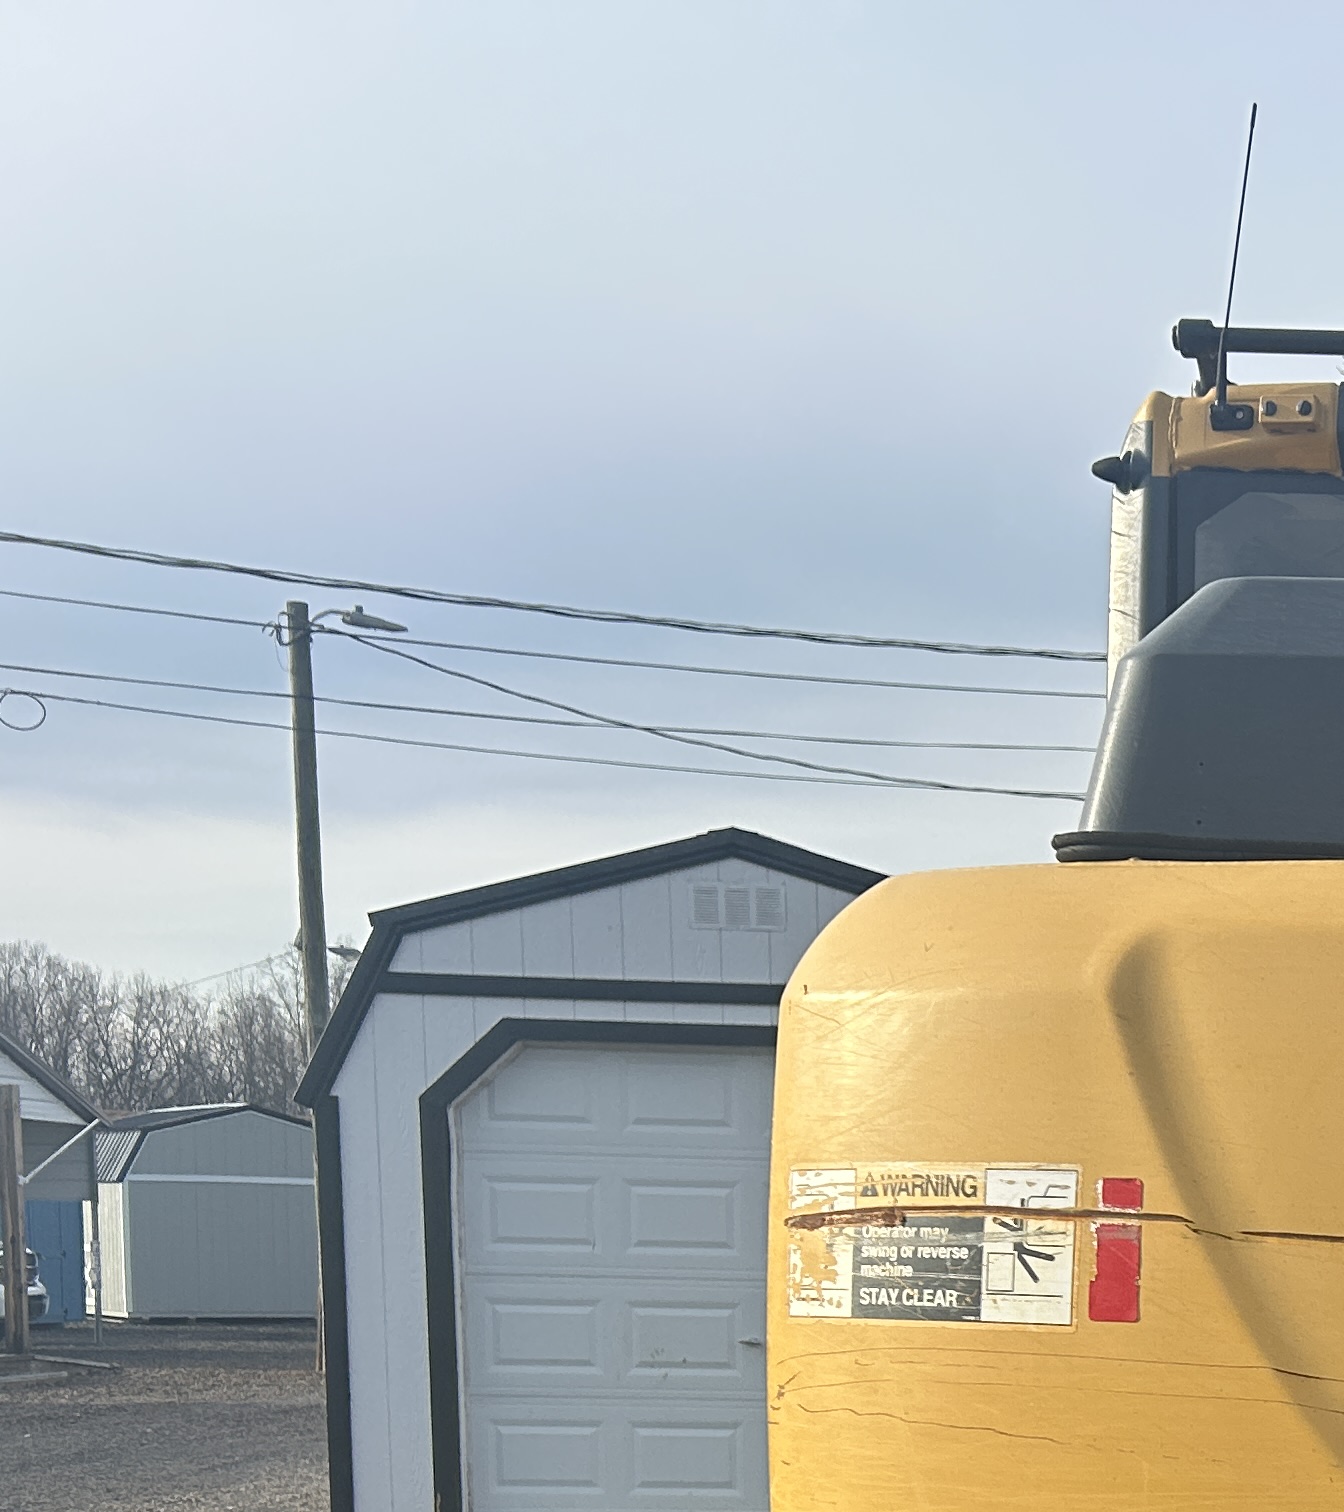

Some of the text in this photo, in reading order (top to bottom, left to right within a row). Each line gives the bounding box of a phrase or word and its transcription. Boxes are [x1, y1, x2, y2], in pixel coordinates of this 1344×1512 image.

[880, 1174, 978, 1198] WARNING
[861, 1225, 949, 1242] Operator may
[861, 1245, 969, 1261] swing or reverse
[859, 1287, 958, 1307] STAY CLEAR
